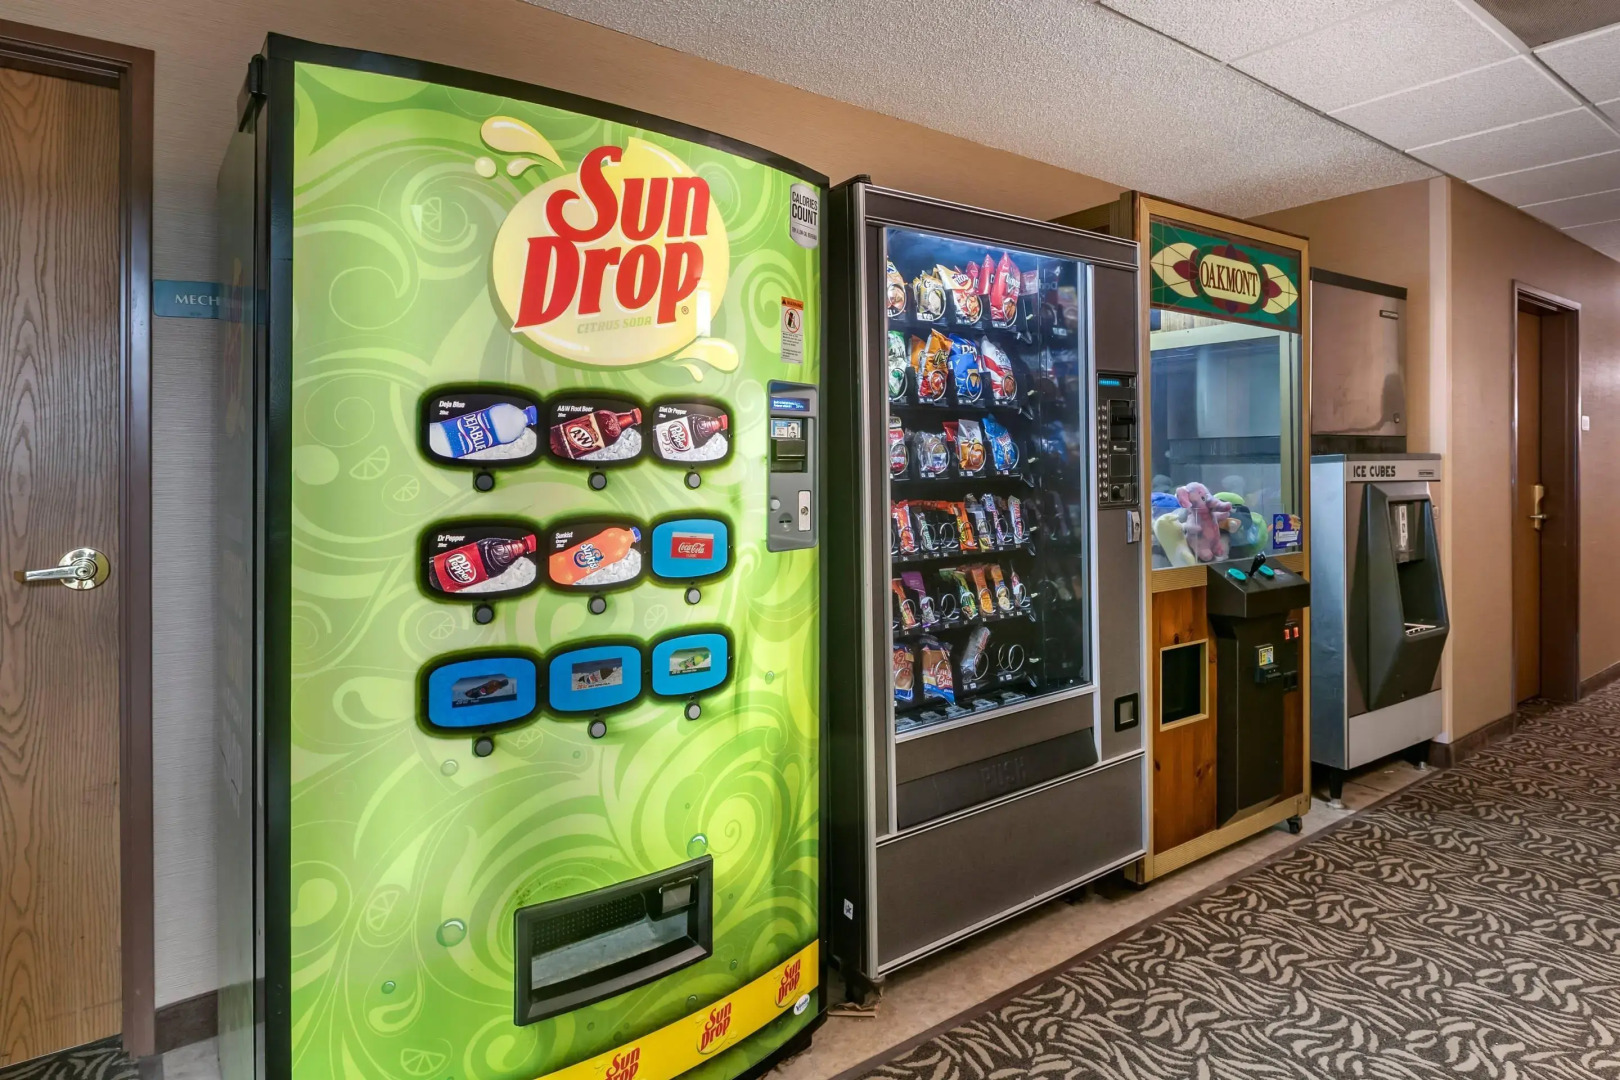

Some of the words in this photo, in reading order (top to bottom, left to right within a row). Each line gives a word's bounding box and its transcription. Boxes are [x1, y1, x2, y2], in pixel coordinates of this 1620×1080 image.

[546, 145, 710, 242] Sun
[792, 192, 818, 211] CALORIES
[792, 203, 818, 226] COUNT
[514, 236, 704, 327] Drop
[1200, 261, 1258, 297] OAKMONT
[174, 294, 220, 306] MECH
[577, 319, 620, 334] CITRUS
[623, 315, 652, 327] SODA
[438, 400, 452, 409] Deja
[1353, 465, 1366, 477] ICE
[1369, 465, 1396, 477] CUBES
[448, 553, 472, 582] Pepper
[462, 561, 472, 574] Dr
[780, 958, 801, 984] Sun
[778, 971, 800, 1006] Drop
[704, 1002, 732, 1030] Sun
[700, 1016, 731, 1052] Drop
[606, 1047, 640, 1077] Sun
